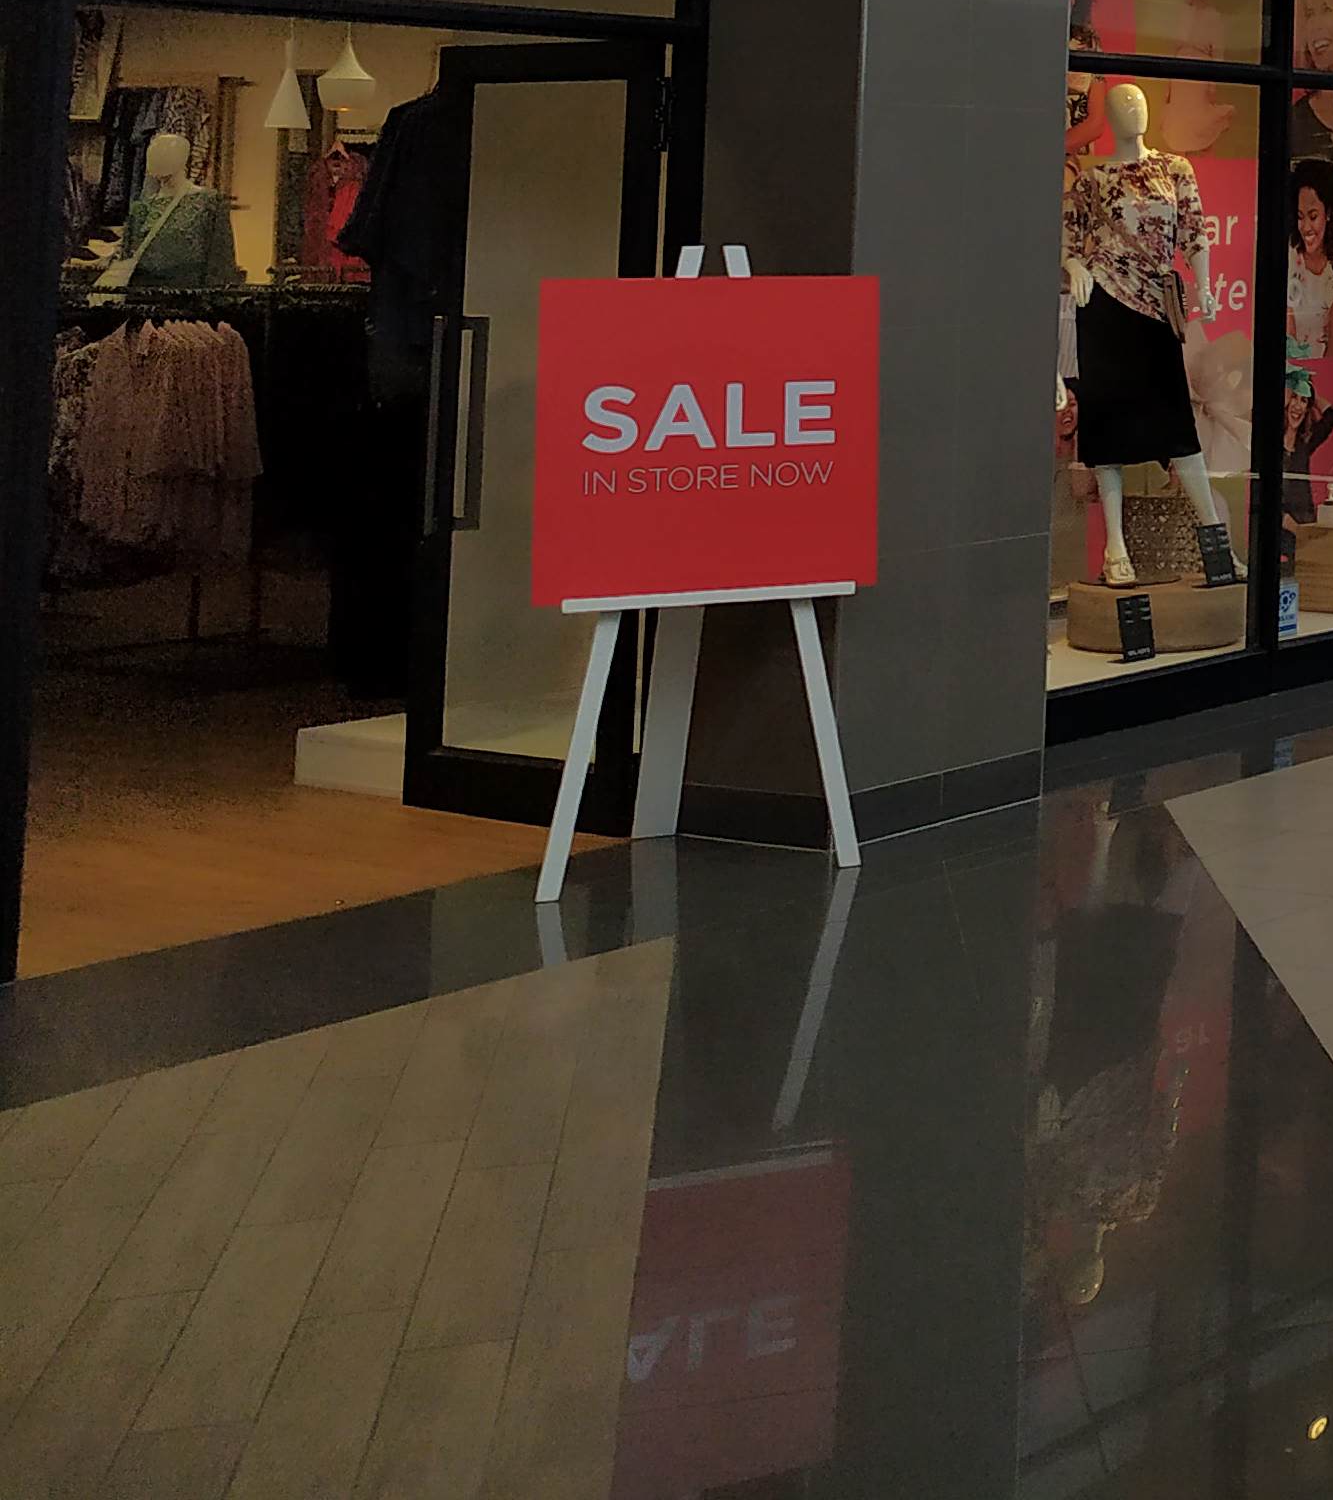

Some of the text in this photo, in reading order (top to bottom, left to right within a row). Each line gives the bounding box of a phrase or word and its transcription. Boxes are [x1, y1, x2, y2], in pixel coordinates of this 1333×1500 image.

[581, 379, 837, 454] SALE
[583, 459, 835, 496] IN STORE NOW
